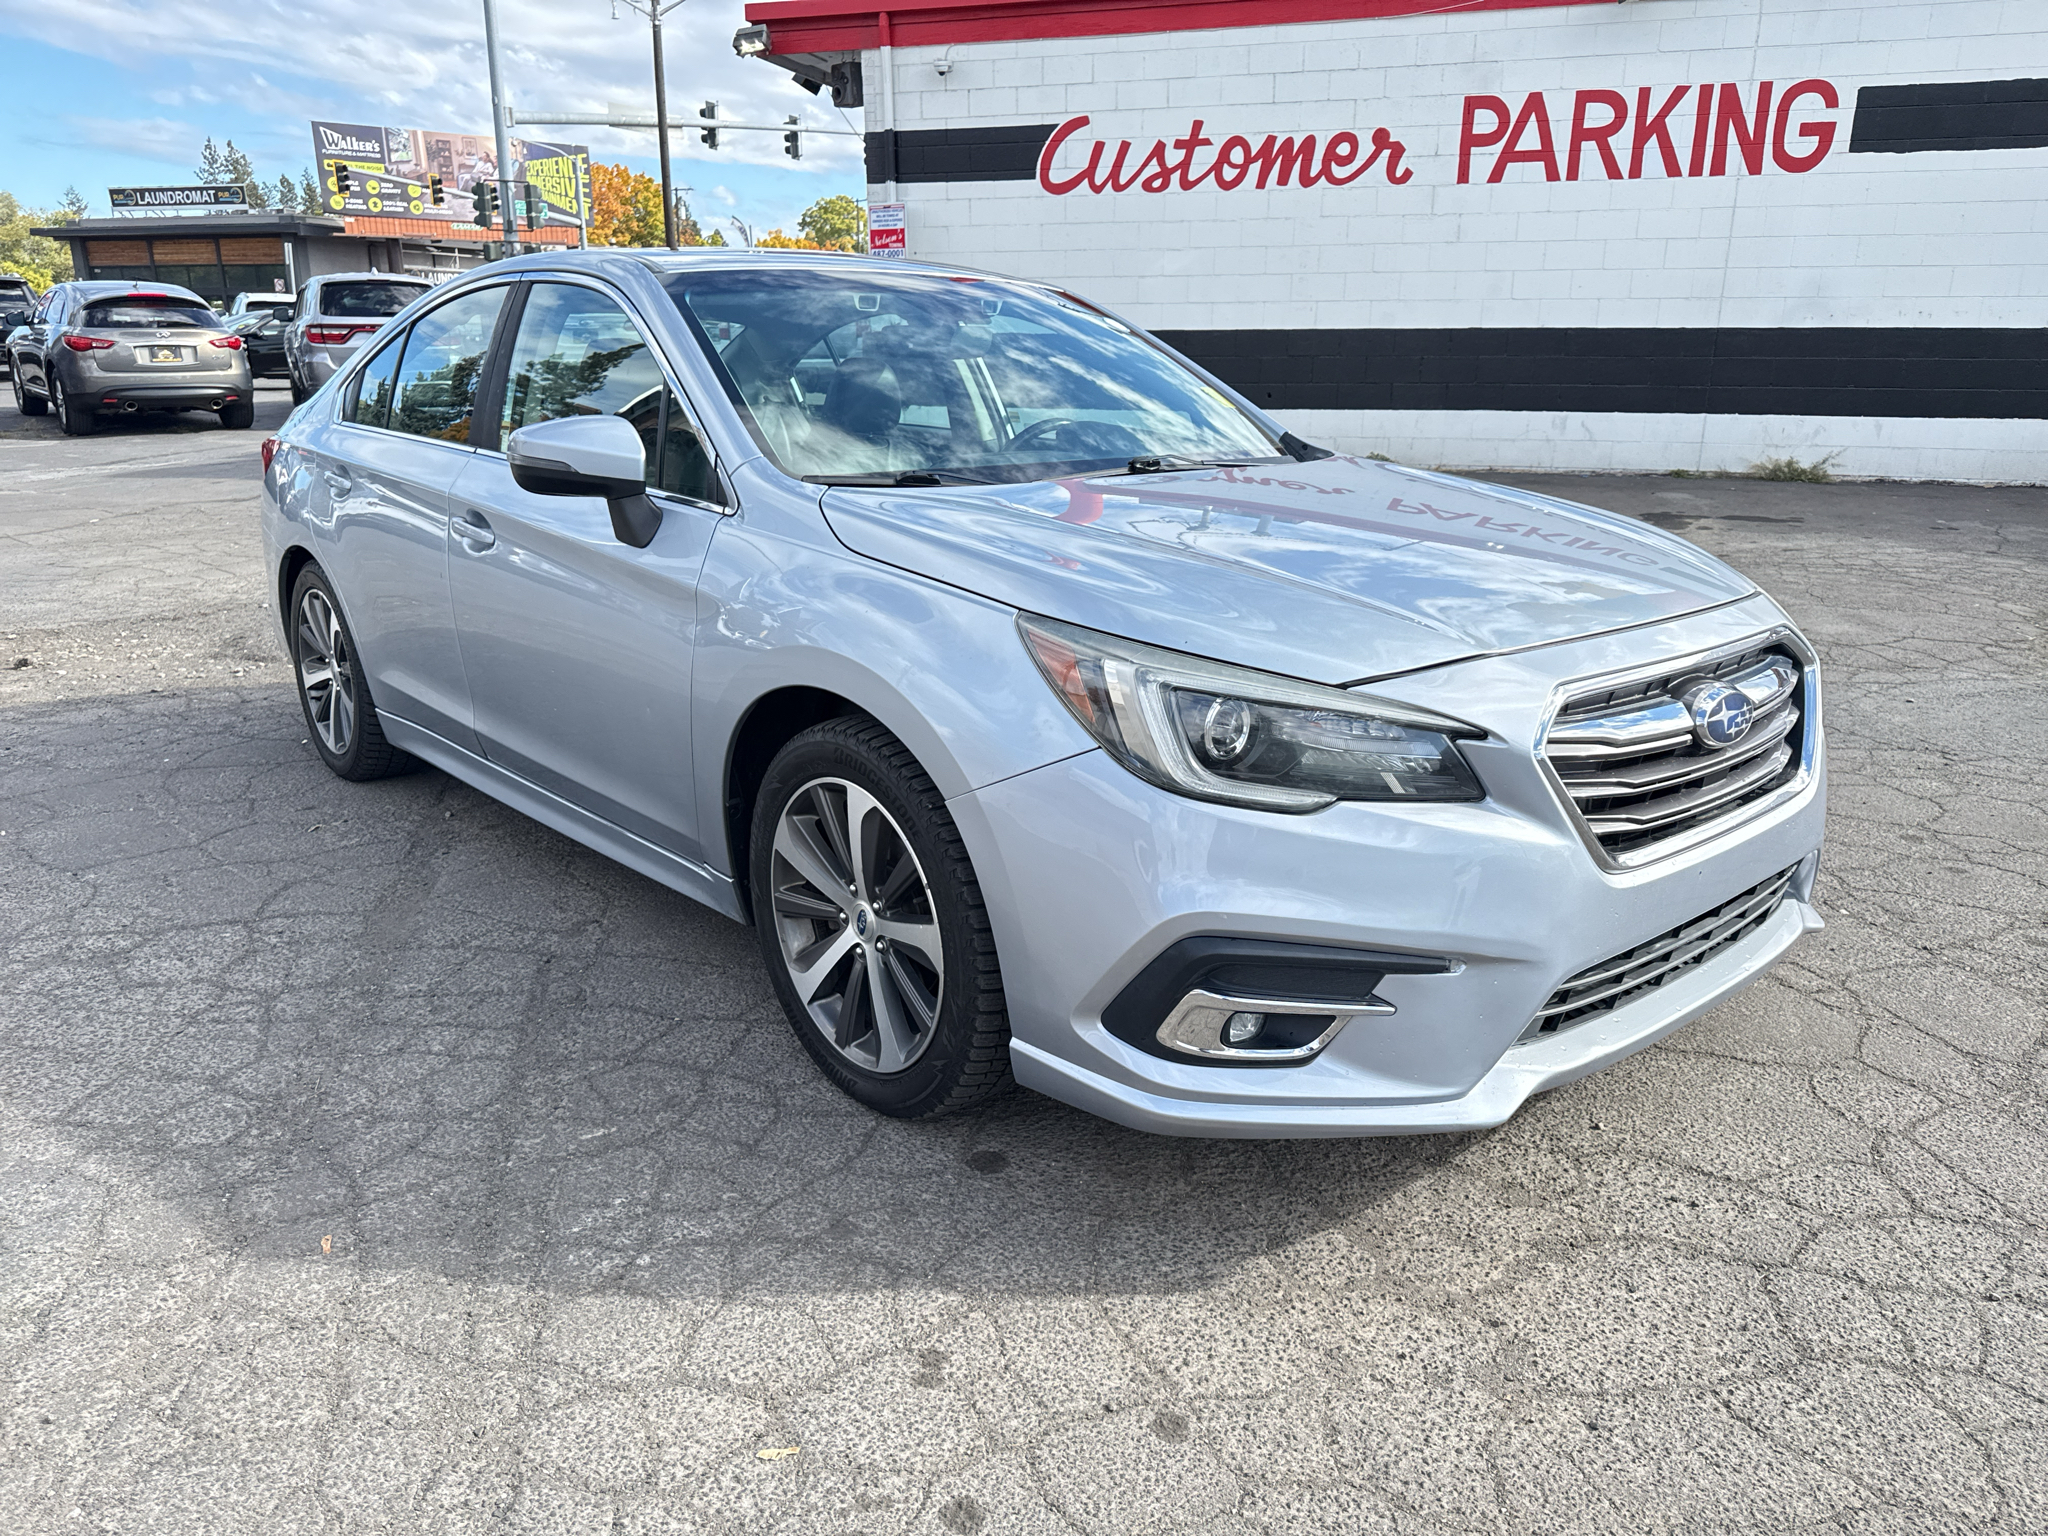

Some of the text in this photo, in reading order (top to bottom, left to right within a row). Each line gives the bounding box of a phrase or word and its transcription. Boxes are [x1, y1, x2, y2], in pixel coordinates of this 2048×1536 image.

[1040, 79, 1840, 195] Customer PARKING
[525, 153, 588, 179] EXPERIENCE
[137, 190, 216, 205] LAUNDROMAT
[872, 229, 903, 247] Nelson's
[873, 249, 903, 258] 487-0001
